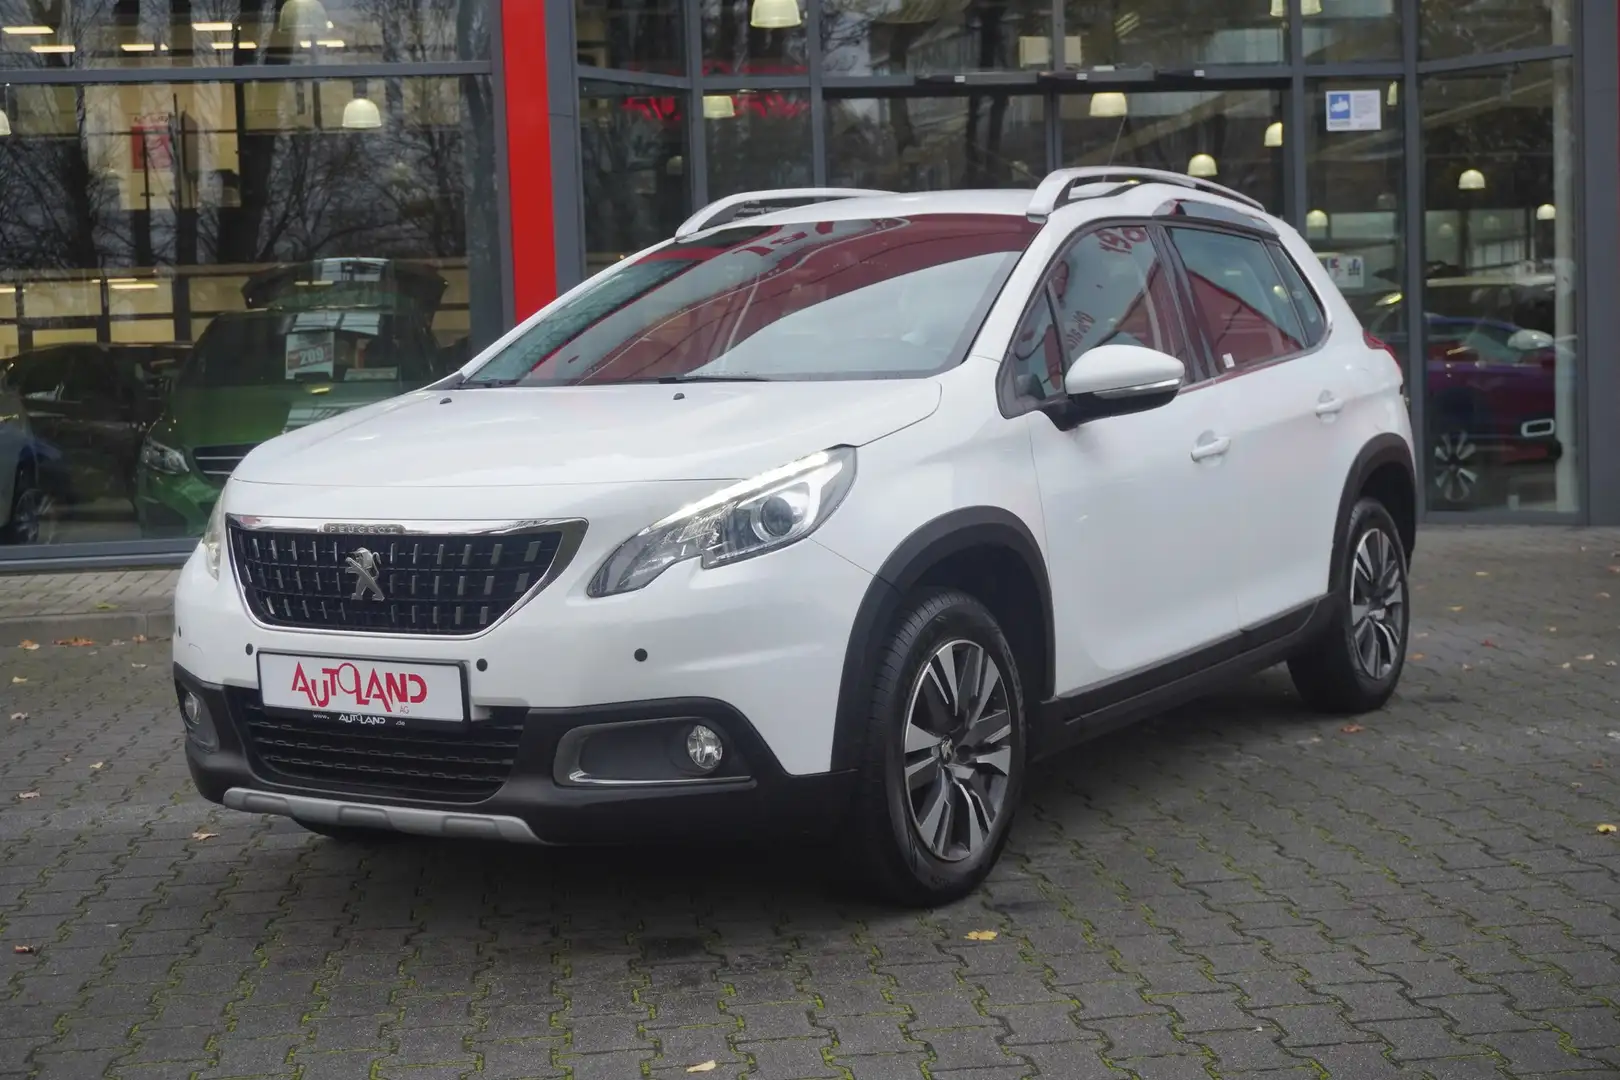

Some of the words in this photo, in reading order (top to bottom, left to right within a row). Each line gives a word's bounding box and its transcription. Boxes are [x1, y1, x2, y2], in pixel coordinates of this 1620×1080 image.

[329, 525, 397, 534] PEUGEOT
[291, 660, 427, 712] AUTOLAND
[399, 705, 410, 715] AG
